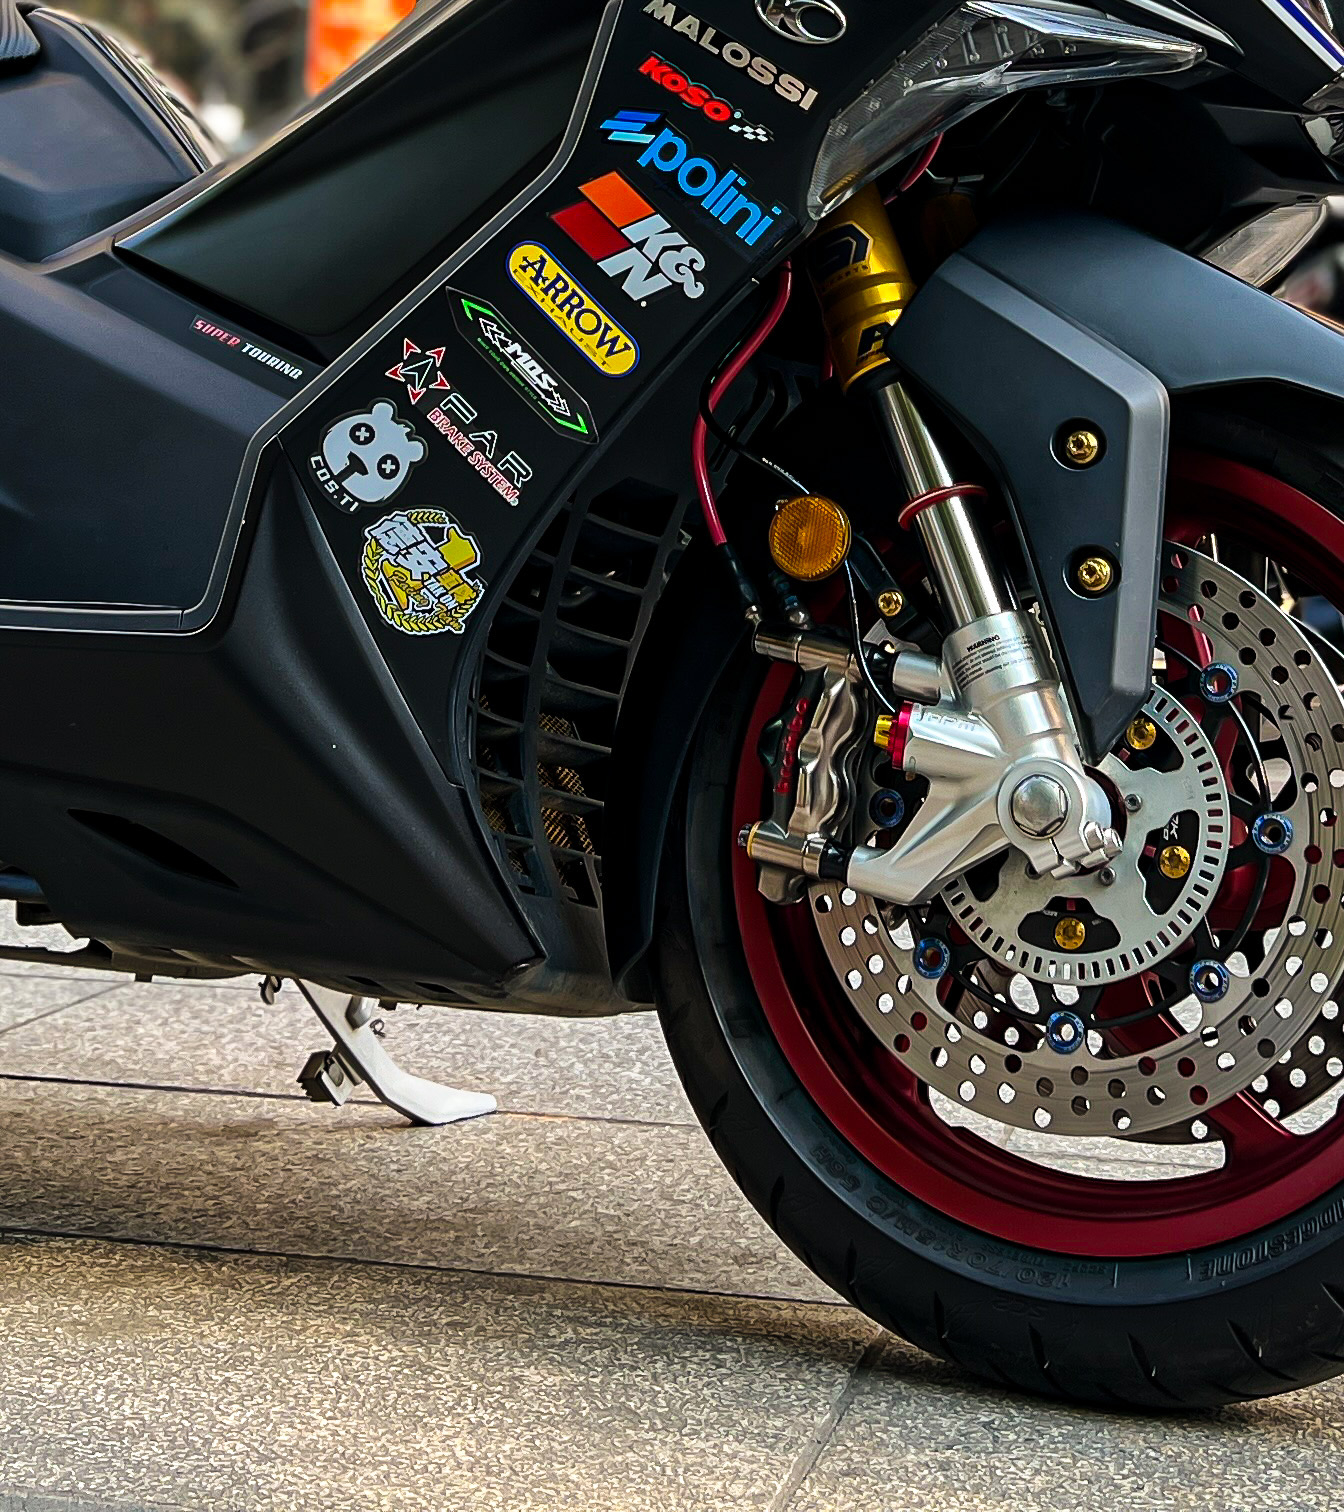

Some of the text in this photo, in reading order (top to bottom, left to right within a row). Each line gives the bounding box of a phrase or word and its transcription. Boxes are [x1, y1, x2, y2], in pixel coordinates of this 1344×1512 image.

[637, 55, 732, 122] KOSO
[636, 127, 783, 247] polini
[193, 319, 303, 380] SUPER TOURING
[519, 253, 633, 359] ARROW
[427, 407, 474, 457] BRAKE
[467, 451, 519, 506] SYSTEM
[439, 392, 533, 489] FAR
